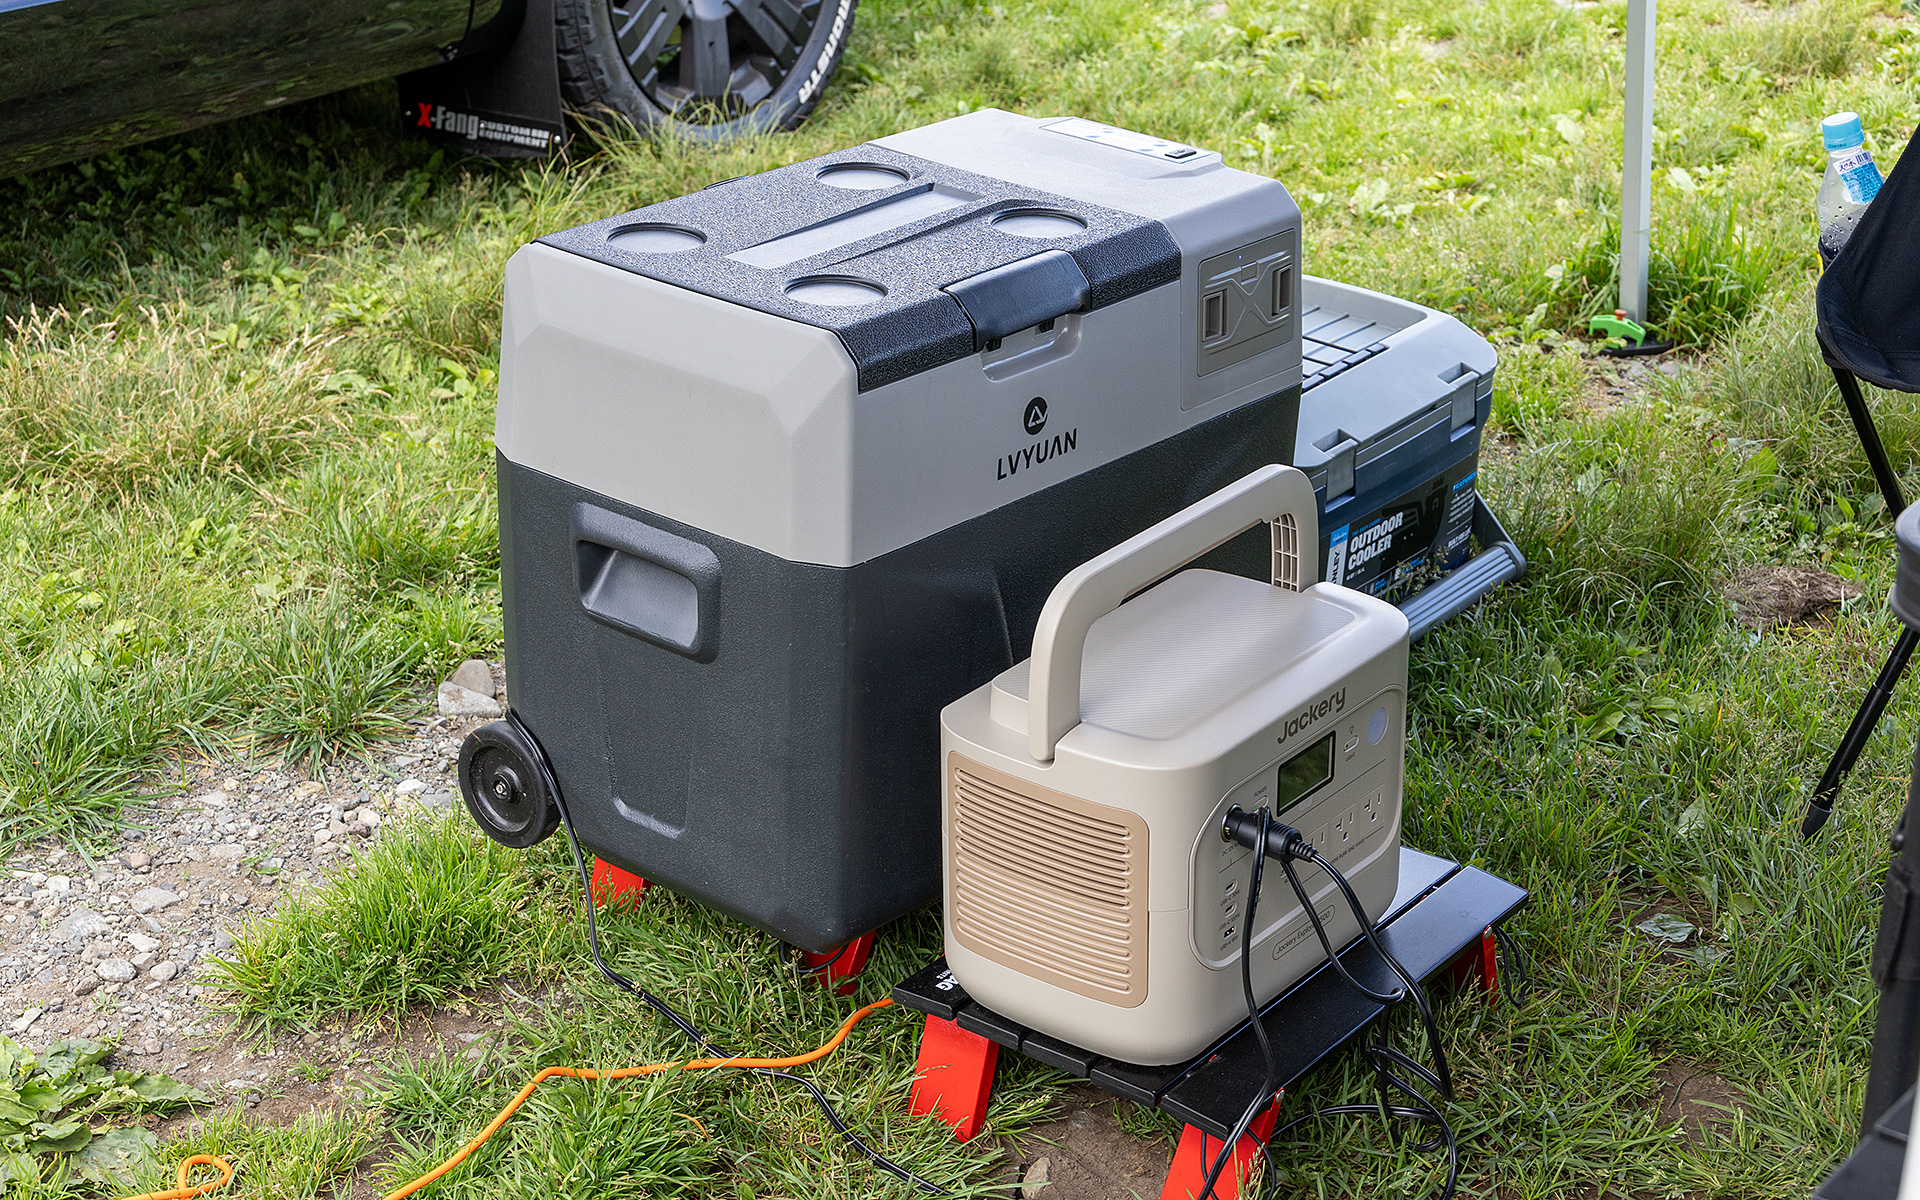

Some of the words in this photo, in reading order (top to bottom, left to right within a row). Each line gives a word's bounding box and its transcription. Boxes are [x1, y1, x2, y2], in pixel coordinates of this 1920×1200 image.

[417, 102, 479, 141] X-Fang
[479, 129, 549, 149] EQUIPMENT
[997, 427, 1078, 481] LVYUAN
[1348, 533, 1392, 571] COOLER
[1350, 511, 1404, 553] OUTDOOR
[1277, 686, 1346, 745] Jackery
